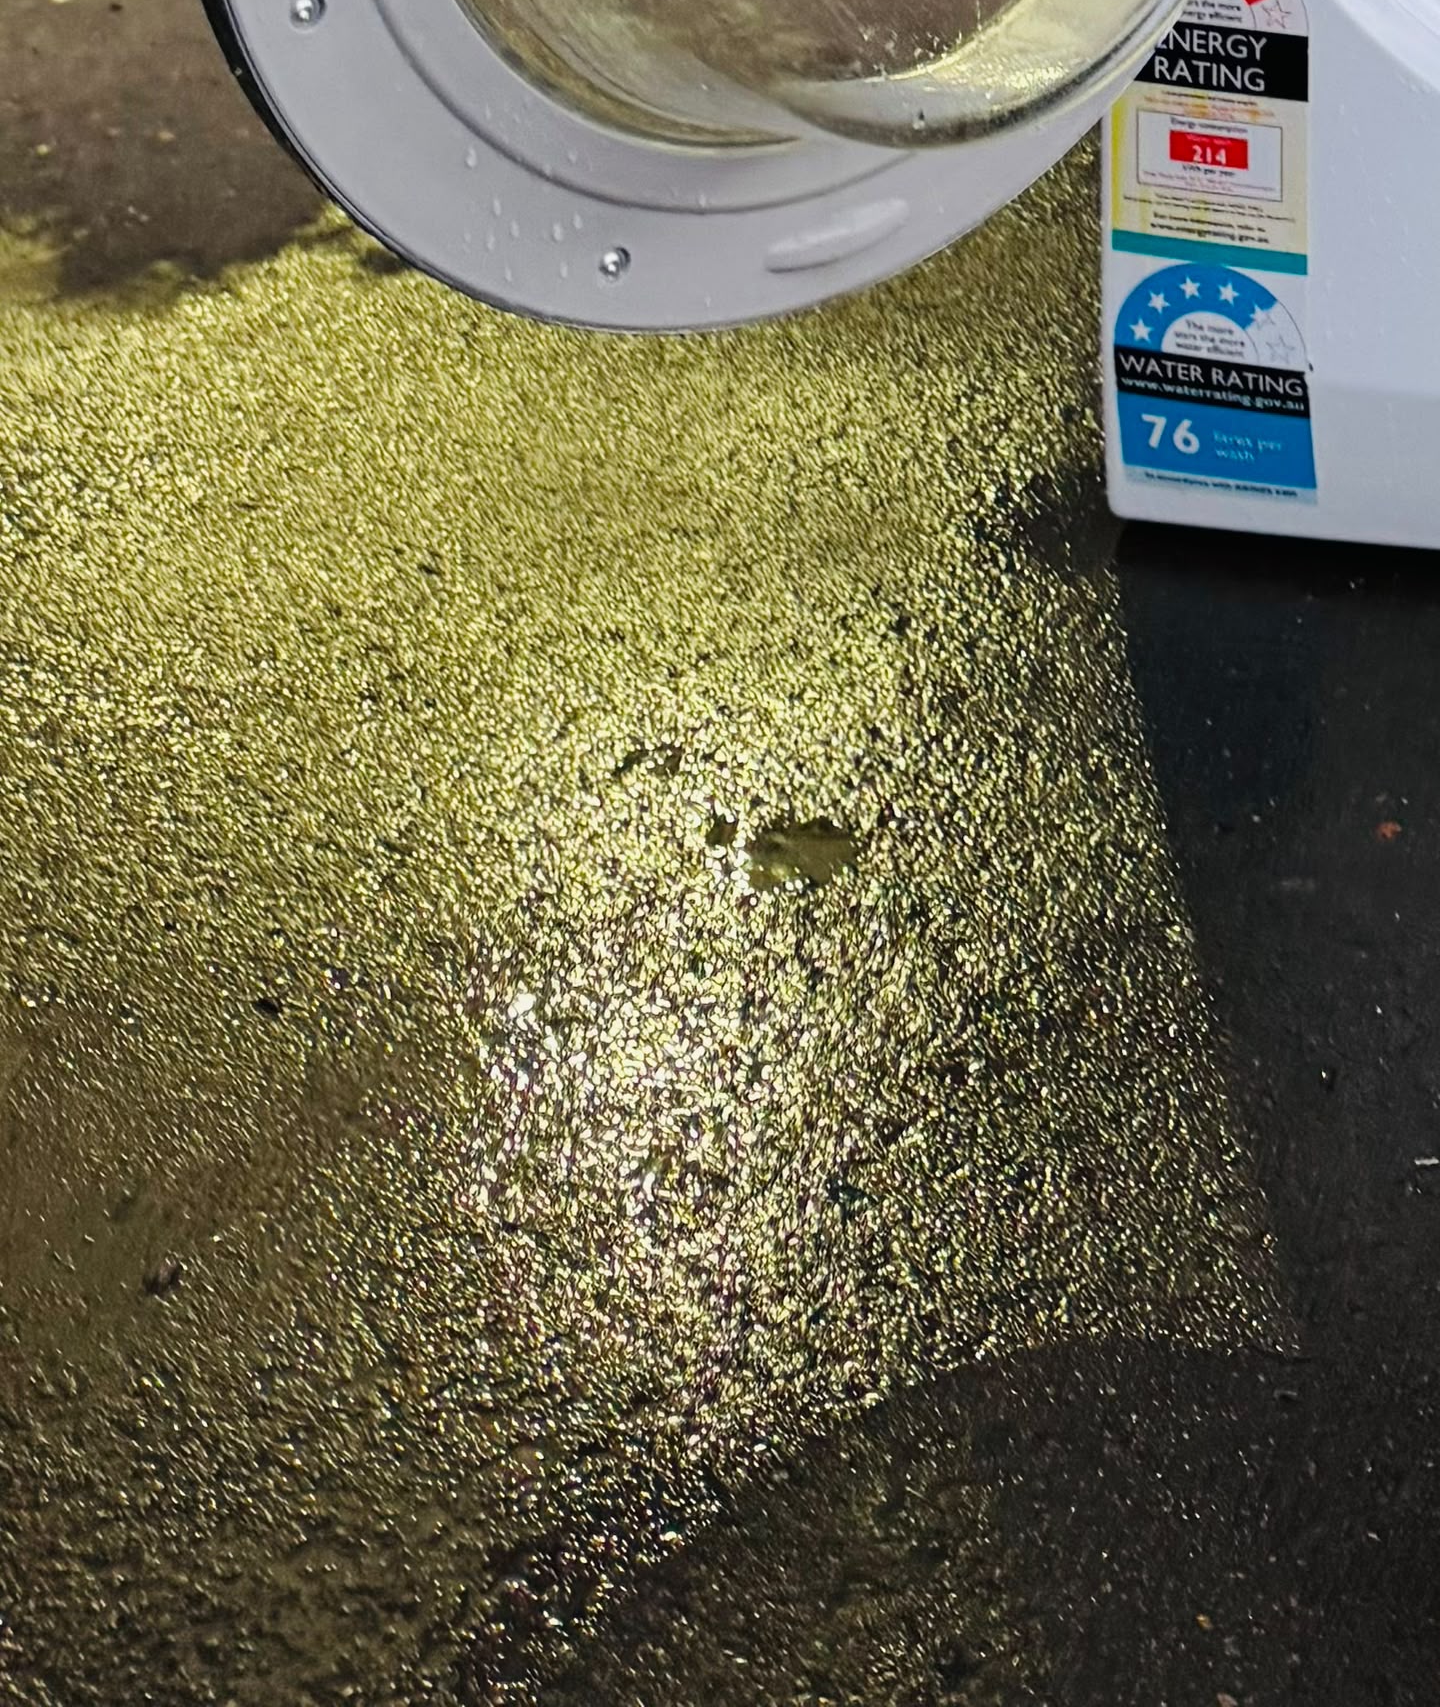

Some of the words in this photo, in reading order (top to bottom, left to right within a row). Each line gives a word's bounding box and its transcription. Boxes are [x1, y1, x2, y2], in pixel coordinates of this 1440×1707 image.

[1153, 55, 1266, 93] RATING
[1191, 144, 1228, 166] 214
[1118, 351, 1205, 384] WATER
[1210, 366, 1304, 397] RATING
[1120, 376, 1305, 412] www.waterrating.gov.au
[1140, 412, 1201, 456] 76
